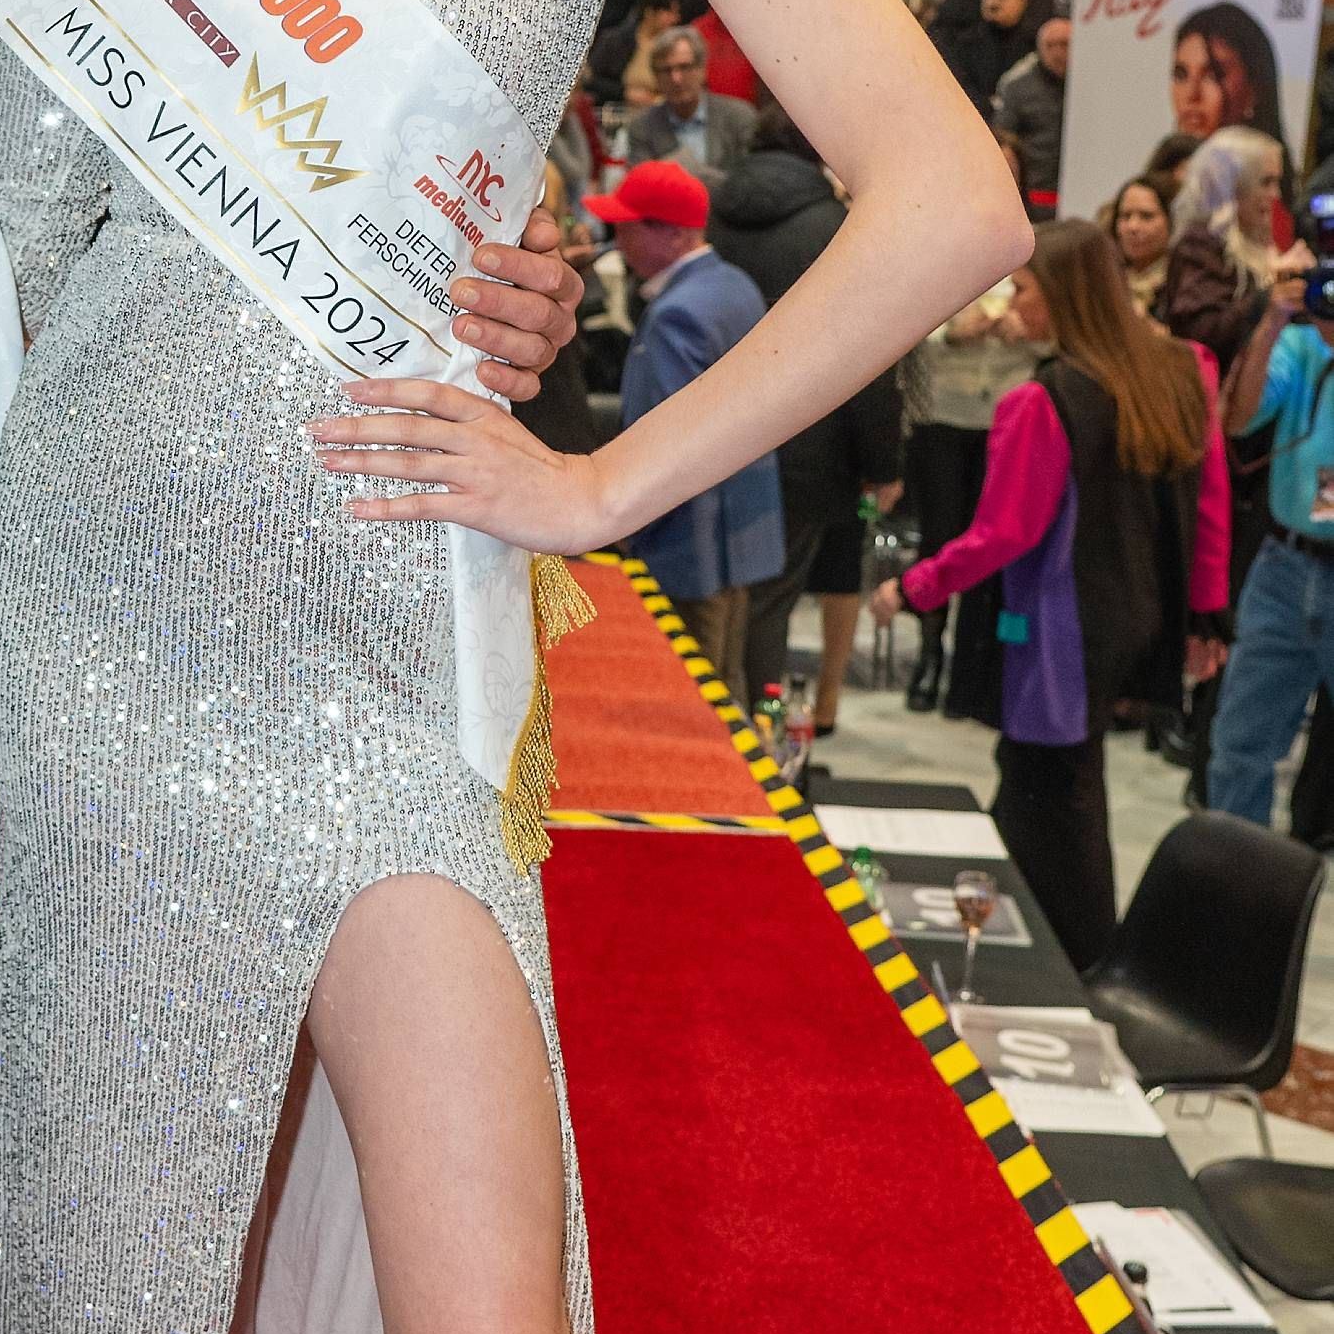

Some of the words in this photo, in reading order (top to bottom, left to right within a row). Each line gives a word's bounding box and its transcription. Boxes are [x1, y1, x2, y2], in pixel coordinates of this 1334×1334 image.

[185, 10, 237, 60] CITY
[44, 6, 146, 109] MISS
[147, 100, 301, 282] VIENNA
[300, 271, 411, 367] 2024
[394, 218, 457, 281] DIETER
[996, 1028, 1076, 1079] 10
